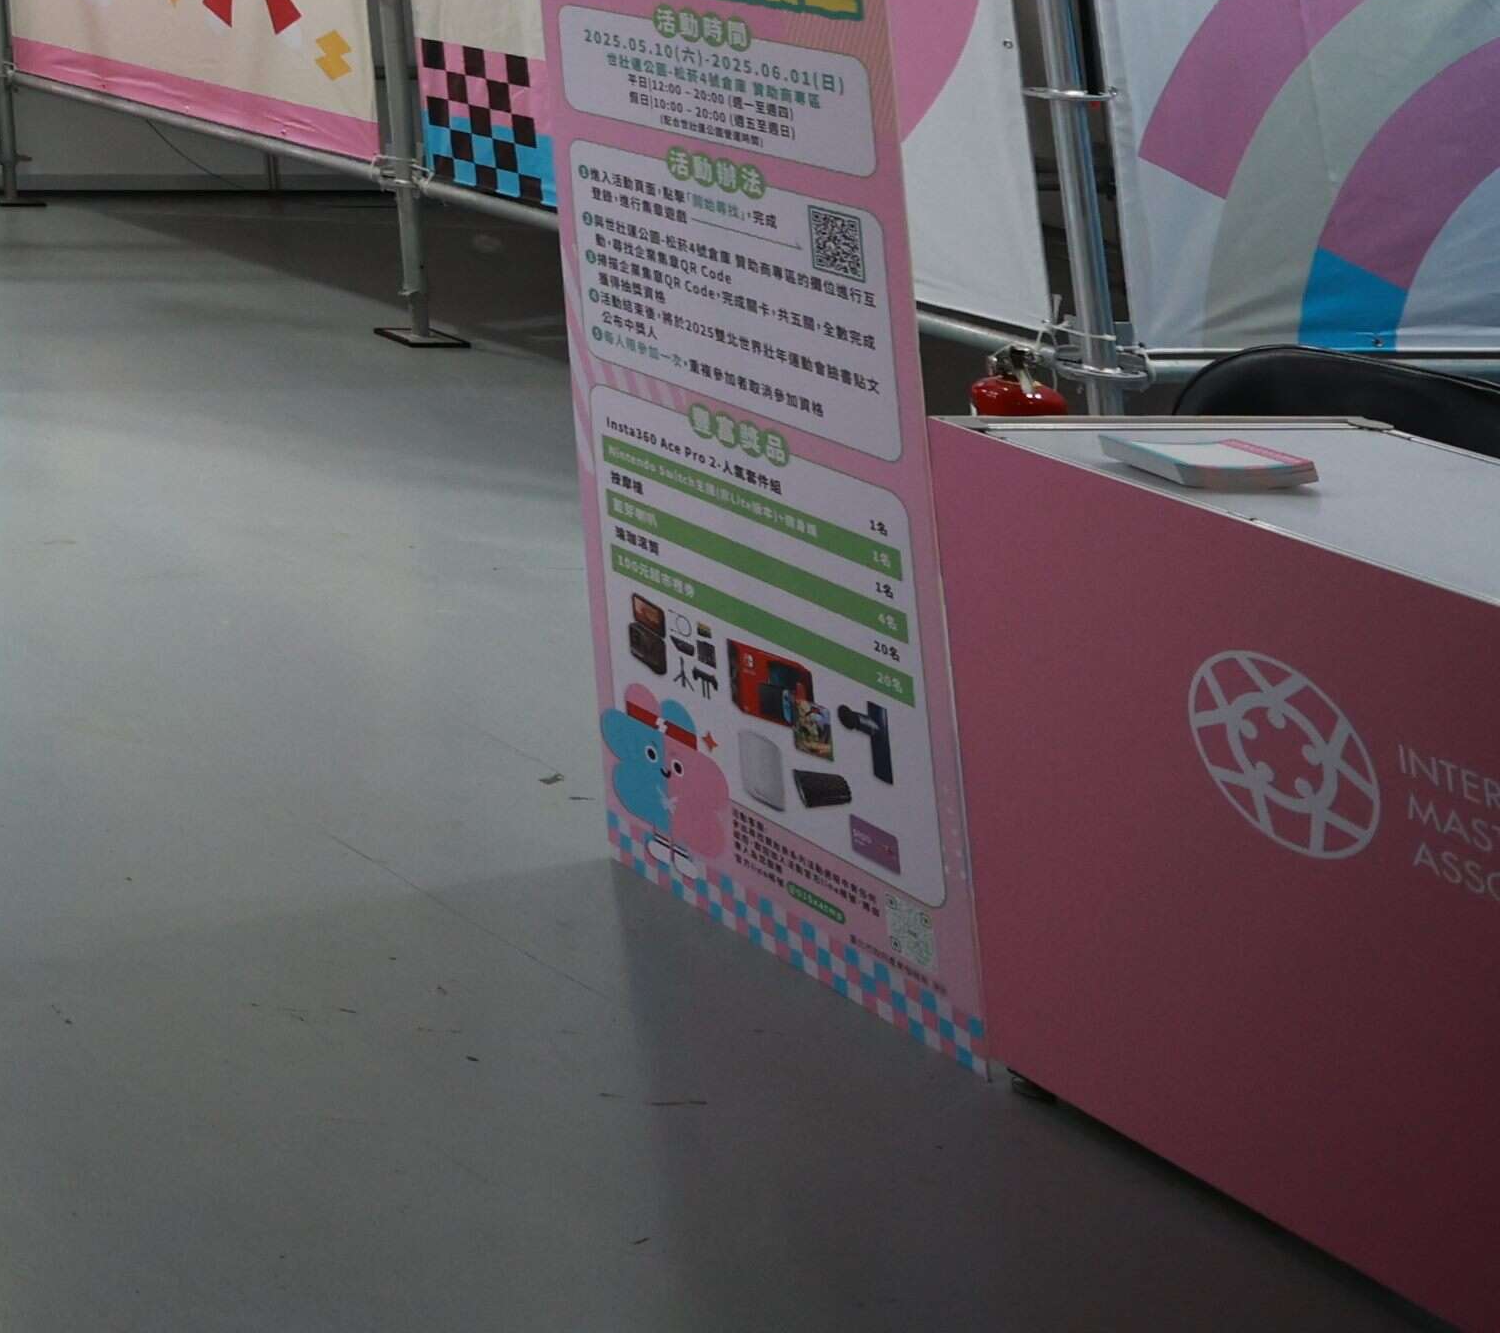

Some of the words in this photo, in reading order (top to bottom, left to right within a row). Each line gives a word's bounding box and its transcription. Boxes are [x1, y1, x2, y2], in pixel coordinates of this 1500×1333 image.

[656, 7, 751, 48] 活動時間
[701, 265, 733, 285] Code
[606, 416, 658, 446] Insta360
[660, 439, 682, 456] Ace
[685, 447, 706, 464] Pro
